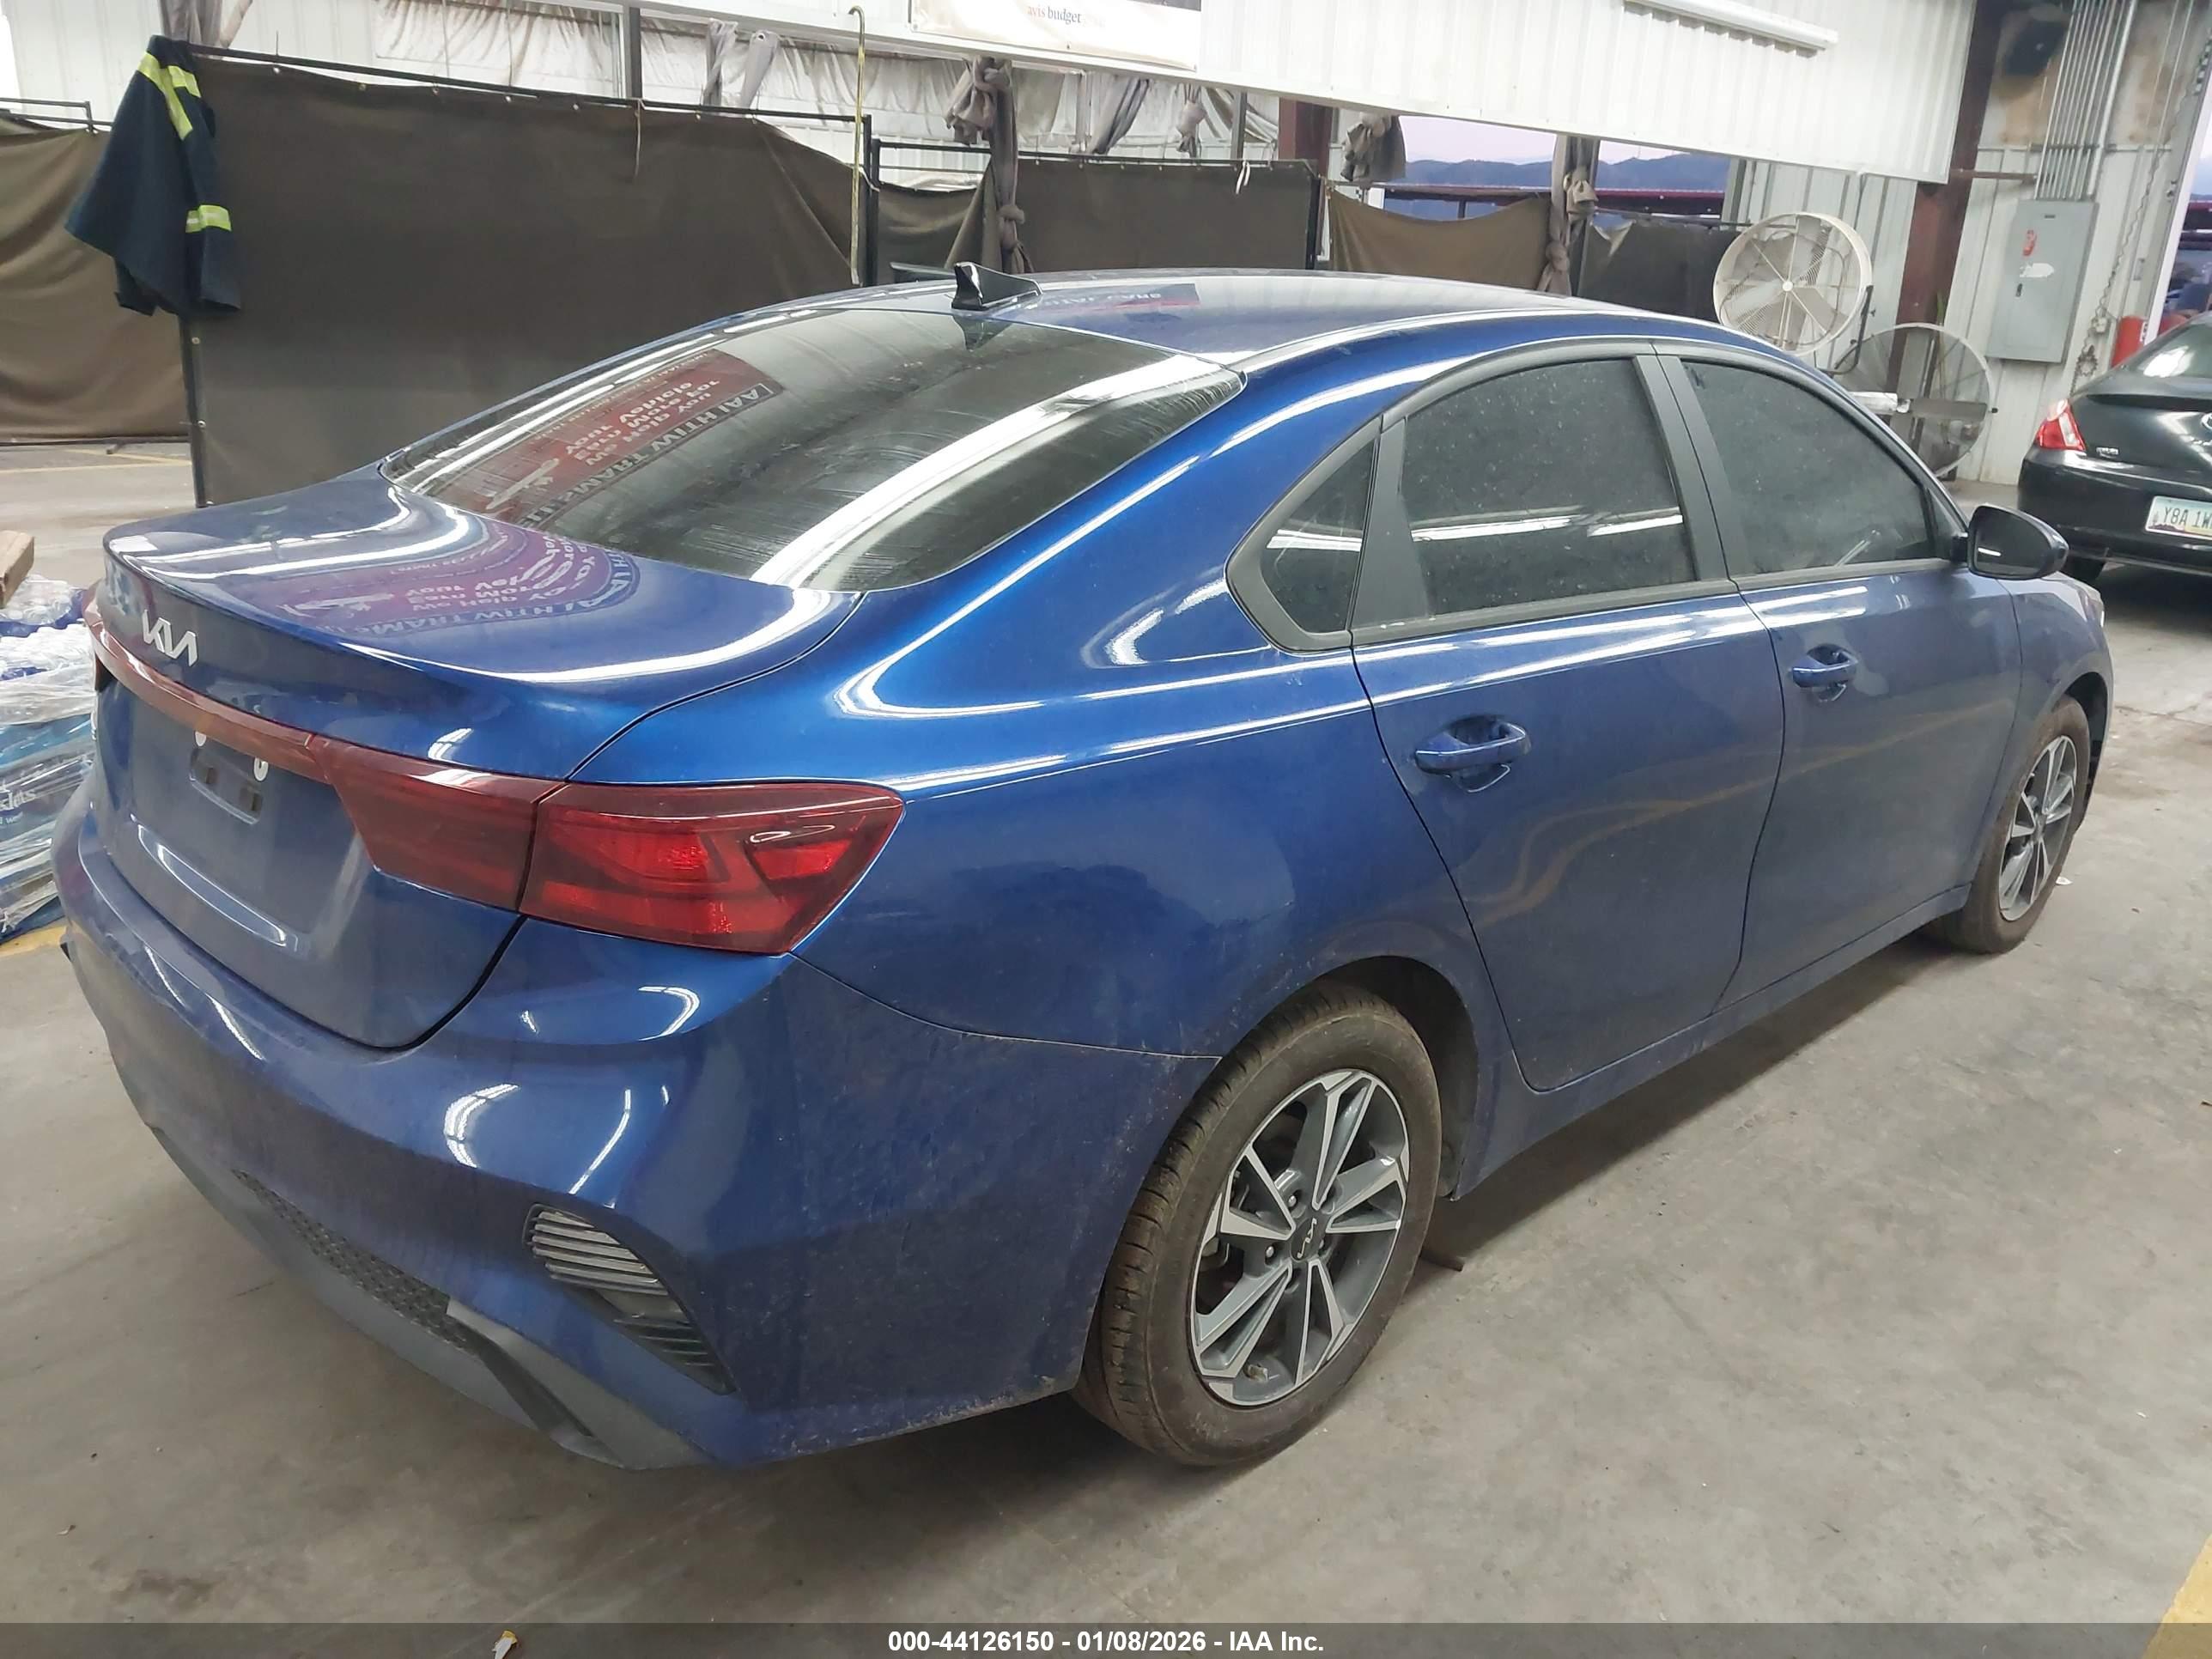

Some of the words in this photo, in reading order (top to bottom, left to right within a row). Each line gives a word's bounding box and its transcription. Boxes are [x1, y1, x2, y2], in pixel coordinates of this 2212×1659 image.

[1028, 4, 1046, 18] avis
[1048, 6, 1082, 25] budget
[2163, 507, 2189, 526] Y8A
[142, 609, 198, 667] KIA
